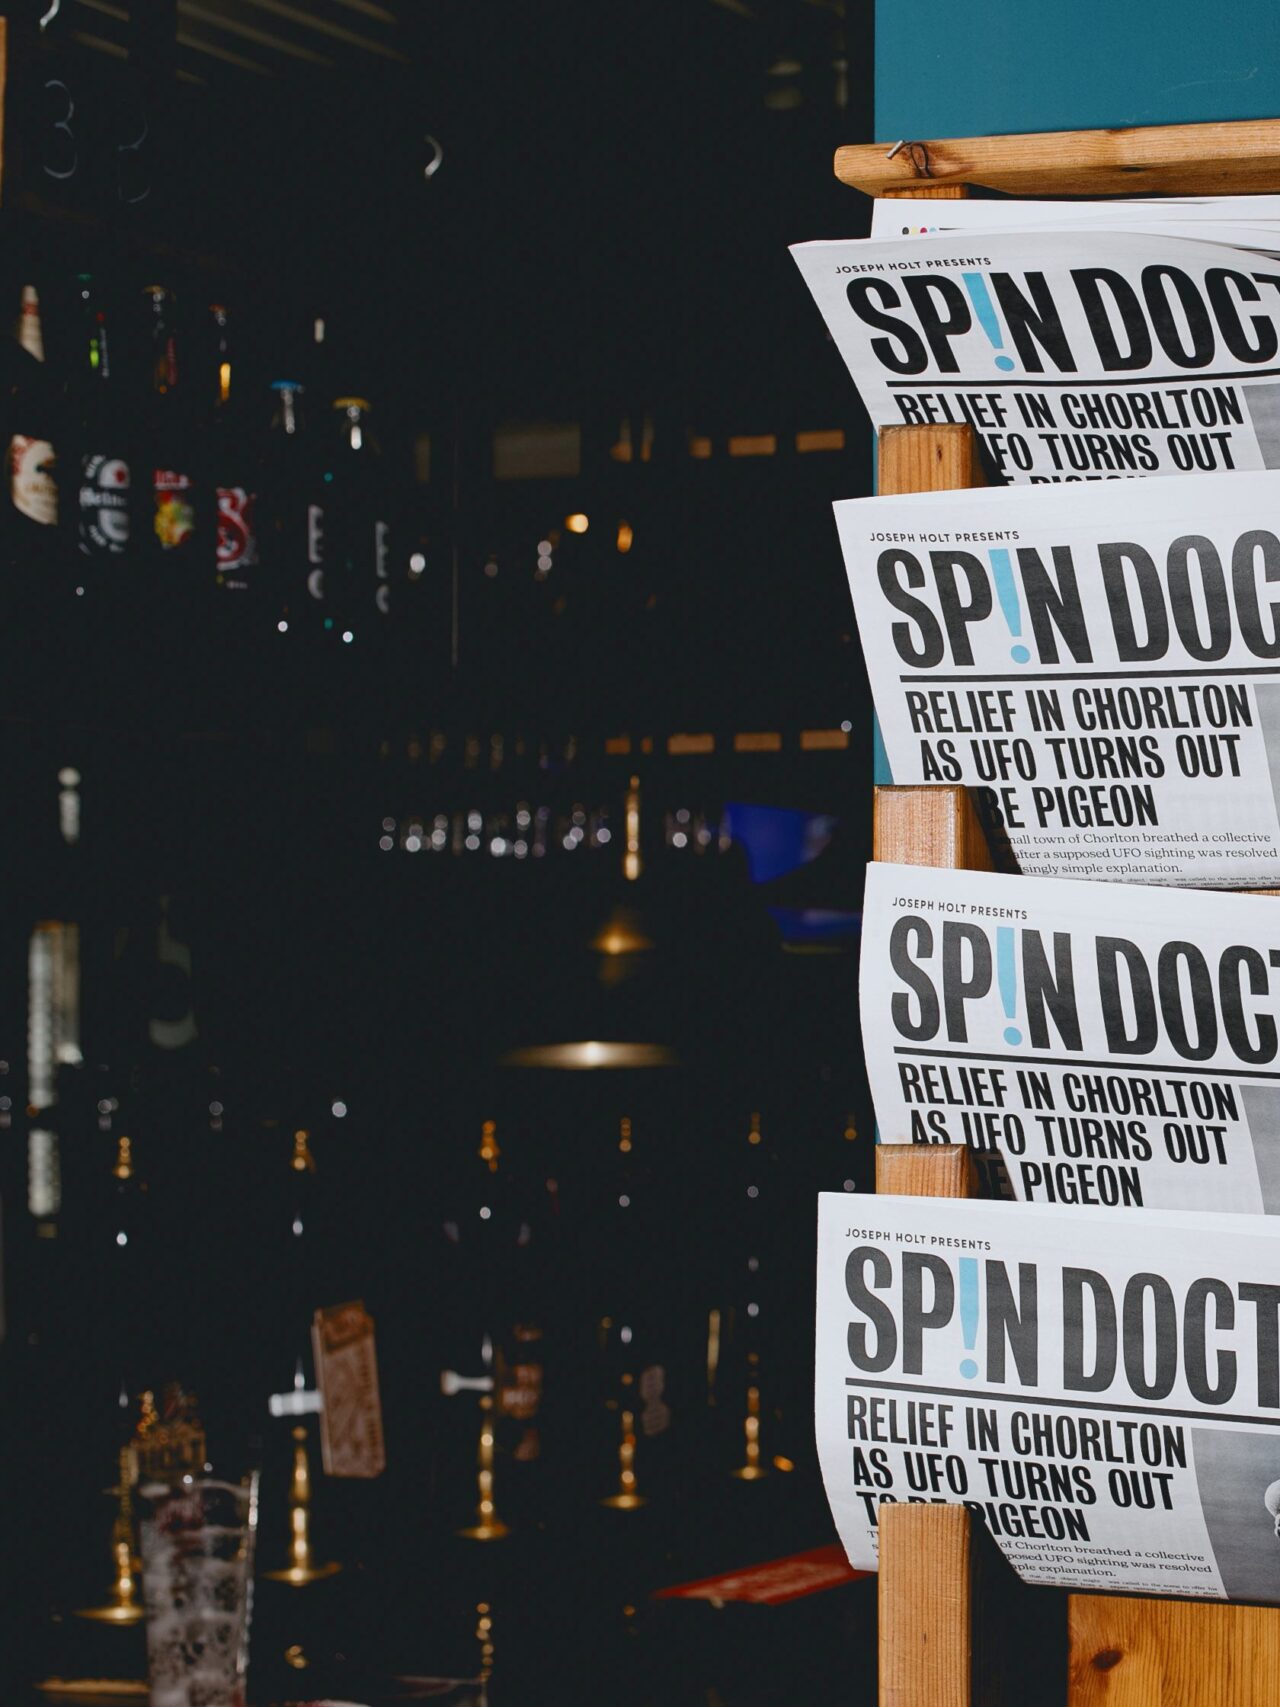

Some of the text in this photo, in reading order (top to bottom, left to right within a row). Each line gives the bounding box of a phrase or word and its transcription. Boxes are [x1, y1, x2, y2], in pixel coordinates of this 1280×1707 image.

[836, 257, 992, 274] JOSEPH HOLT PRESENTS
[1013, 392, 1055, 428] IN
[1060, 386, 1245, 429] CHORLTON
[982, 432, 1237, 471] FO TURNS OUT
[870, 531, 1020, 543] JOSEPH HOLT PRESENTS
[905, 683, 1254, 734] RELIEF IN CHORLTON
[919, 734, 1241, 782] AS UFO TURNS OUT
[1031, 784, 1160, 829] PIGEON
[1034, 836, 1065, 845] town
[1068, 833, 1081, 844] of
[1083, 833, 1140, 844] Chorlton
[1143, 832, 1199, 843] breathed
[1212, 832, 1271, 843] collective
[1044, 851, 1051, 859] a
[1053, 849, 1110, 862] supposed
[1113, 848, 1142, 858] UFO
[1144, 847, 1196, 861] sighting
[1199, 849, 1223, 858] was
[1225, 847, 1278, 858] resolved
[1062, 863, 1103, 875] simple
[1106, 862, 1183, 875] explanation.
[892, 897, 1027, 920] JOSEPH HOLT PRESENTS
[898, 1062, 1240, 1122] RELIEF IN CHORLTON
[910, 1109, 1228, 1165] AS UFO TURNS OUT
[1019, 1160, 1144, 1208] PIGEON
[845, 1228, 991, 1250] JOSEPH HOLT PRESENTS
[847, 1394, 1187, 1469] RELIEF IN CHORLTON
[853, 1446, 1174, 1511] AS UFO TURNS OUT
[856, 1491, 1092, 1542] T PIGEON
[1000, 1541, 1013, 1549] of
[1015, 1542, 1072, 1553] Chorlton
[1074, 1544, 1132, 1557] breathed
[1144, 1549, 1205, 1562] collective
[1006, 1553, 1212, 1573] posed UFO sighting was resolved
[1039, 1564, 1117, 1578] explanation.
